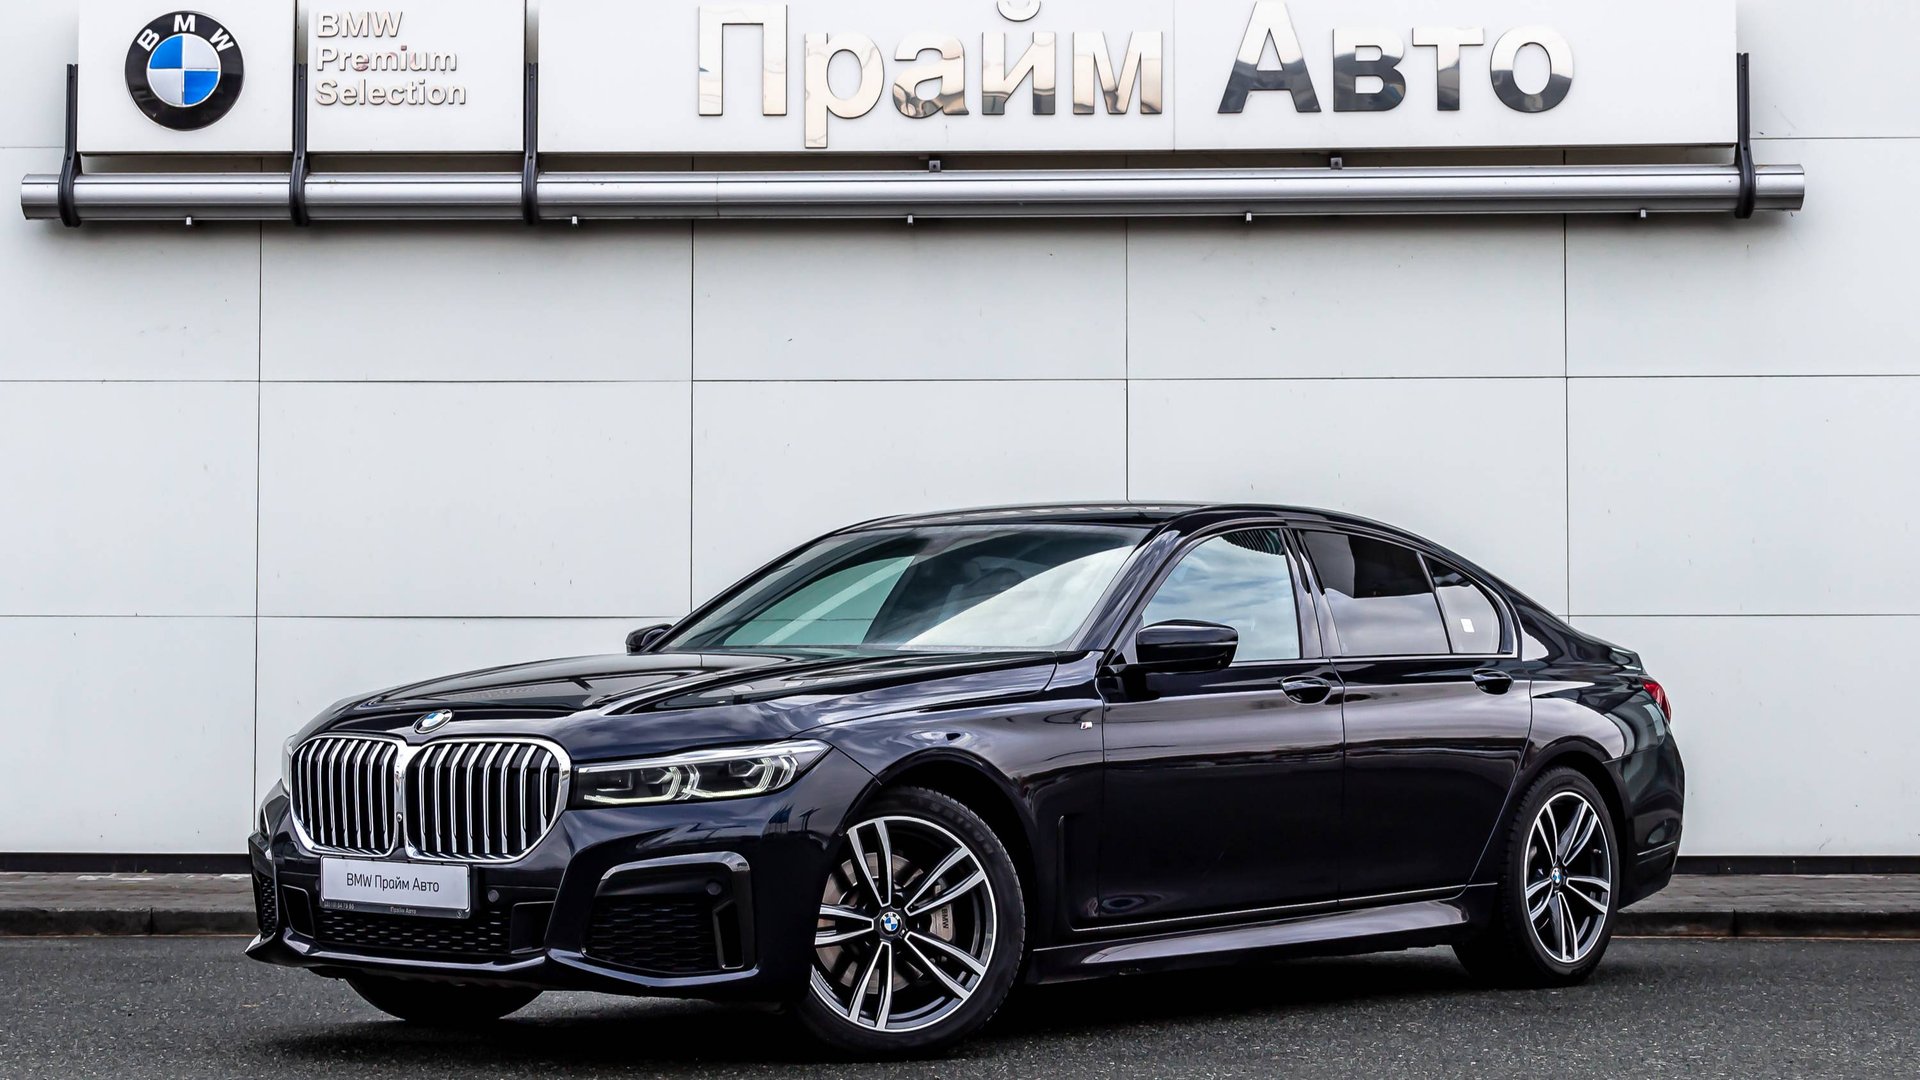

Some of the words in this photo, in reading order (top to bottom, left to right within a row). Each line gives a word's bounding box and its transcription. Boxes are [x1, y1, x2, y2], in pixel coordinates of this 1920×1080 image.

[137, 14, 235, 52] BMW
[316, 11, 403, 38] BMW
[316, 45, 457, 72] Premium
[697, 0, 1163, 149] Прайм
[1217, 0, 1575, 115] Авто
[315, 79, 467, 106] Selection
[346, 872, 373, 888] BMW
[374, 874, 410, 892] Прайм
[412, 877, 440, 893] Авто
[941, 908, 949, 929] BMW
